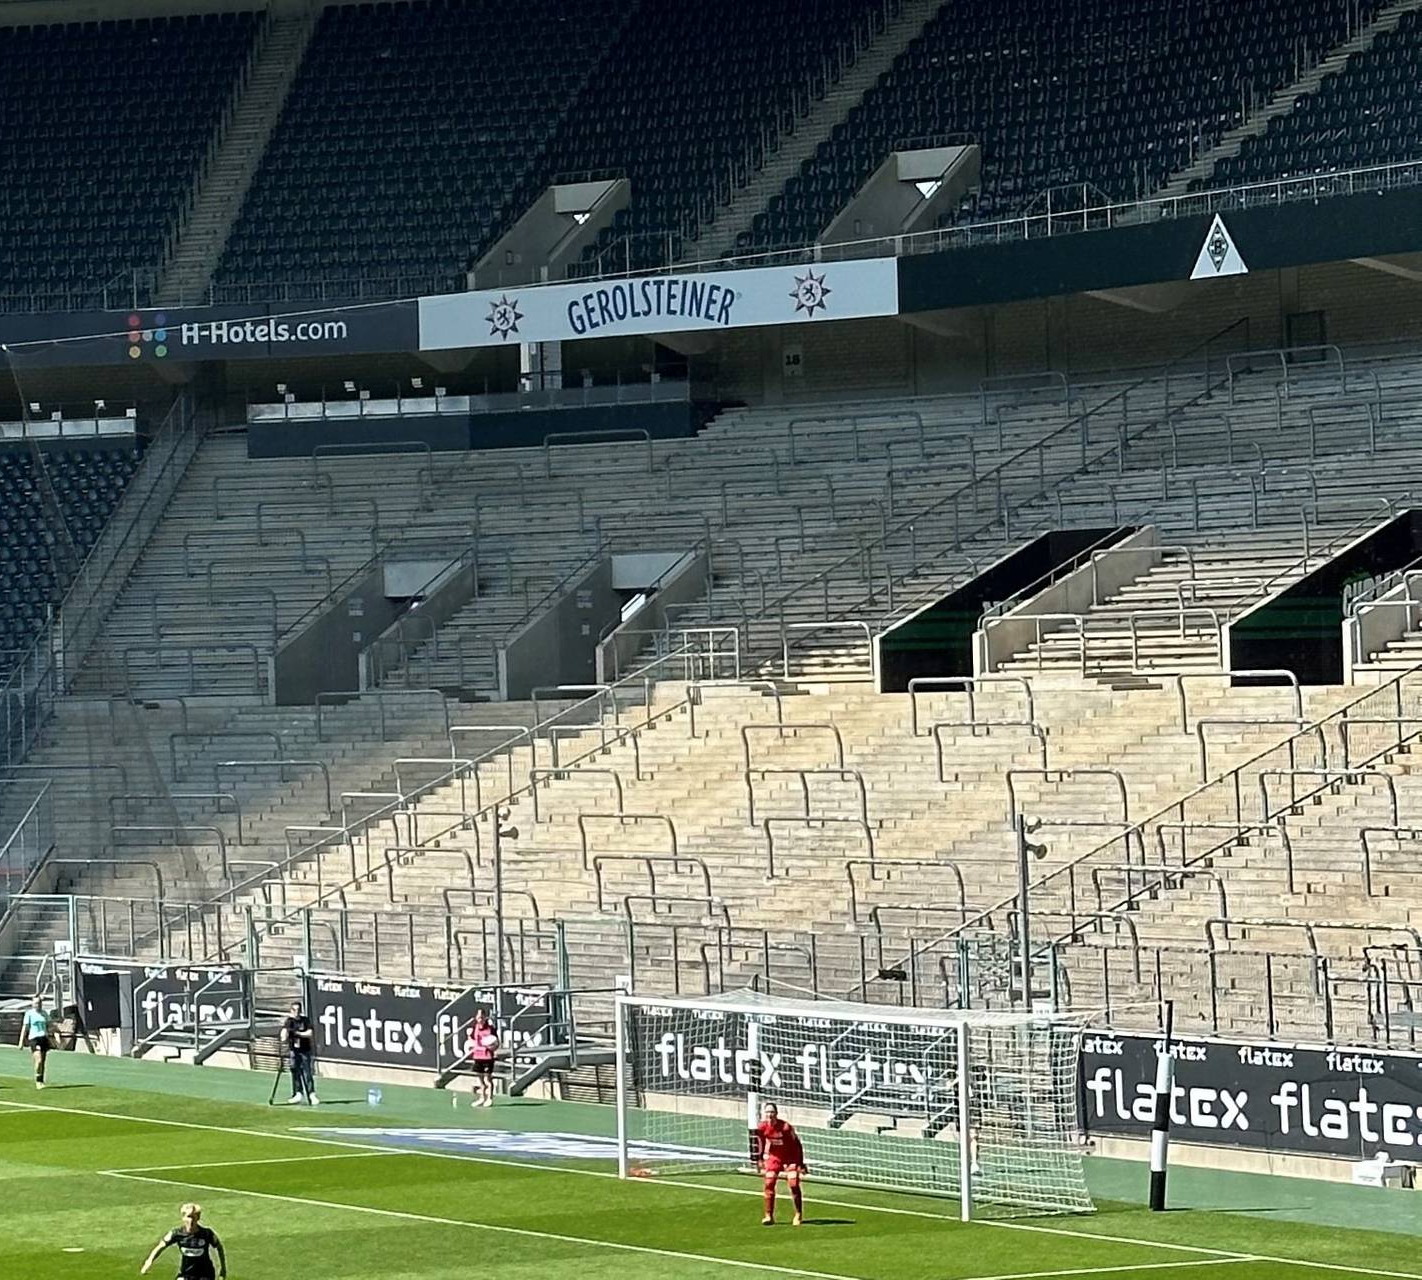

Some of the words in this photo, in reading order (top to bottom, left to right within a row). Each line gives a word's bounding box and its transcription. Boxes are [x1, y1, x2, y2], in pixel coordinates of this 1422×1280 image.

[181, 318, 348, 345] H-Hotels.com
[568, 279, 735, 335] GEROLSTEINER
[319, 1005, 423, 1055] flatex
[1238, 1046, 1294, 1068] flatex
[1326, 1052, 1385, 1074] flatex
[1086, 1067, 1249, 1131] flatex
[1271, 1081, 1422, 1147] flate
